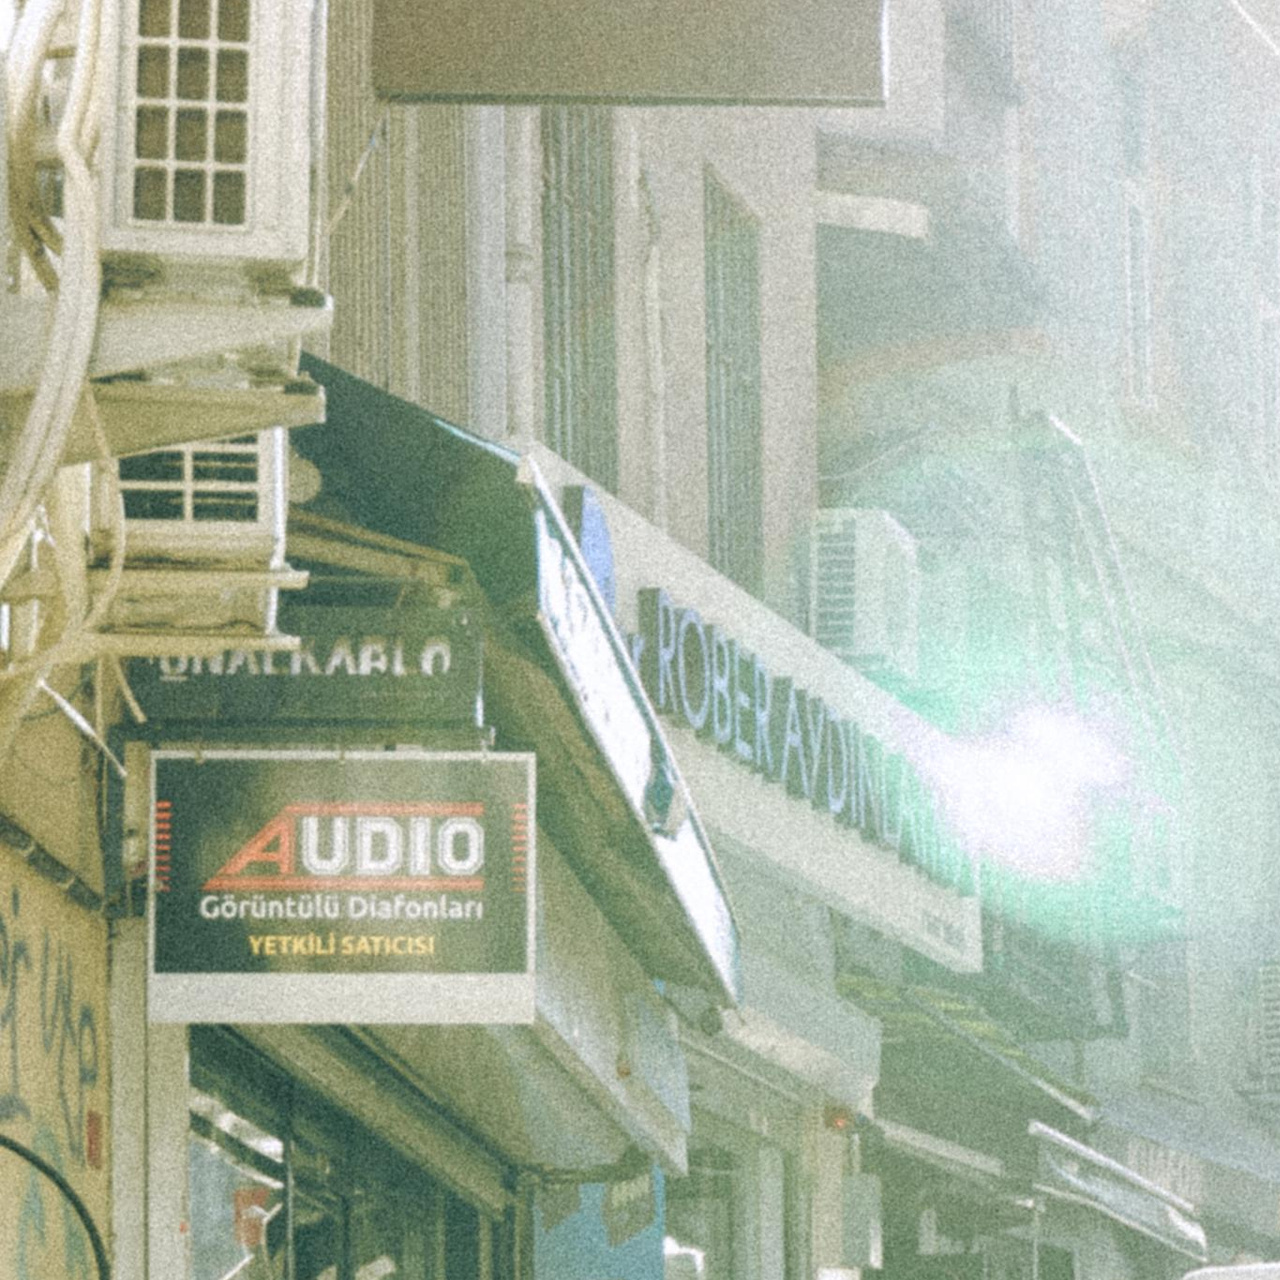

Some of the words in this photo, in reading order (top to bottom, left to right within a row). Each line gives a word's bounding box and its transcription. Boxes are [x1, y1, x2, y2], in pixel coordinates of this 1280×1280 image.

[203, 804, 485, 890] AUDIO
[199, 894, 341, 920] Görüntülü
[347, 894, 484, 920] Diafonları
[248, 931, 336, 957] YETKİLİ
[342, 933, 436, 957] SATICISI
